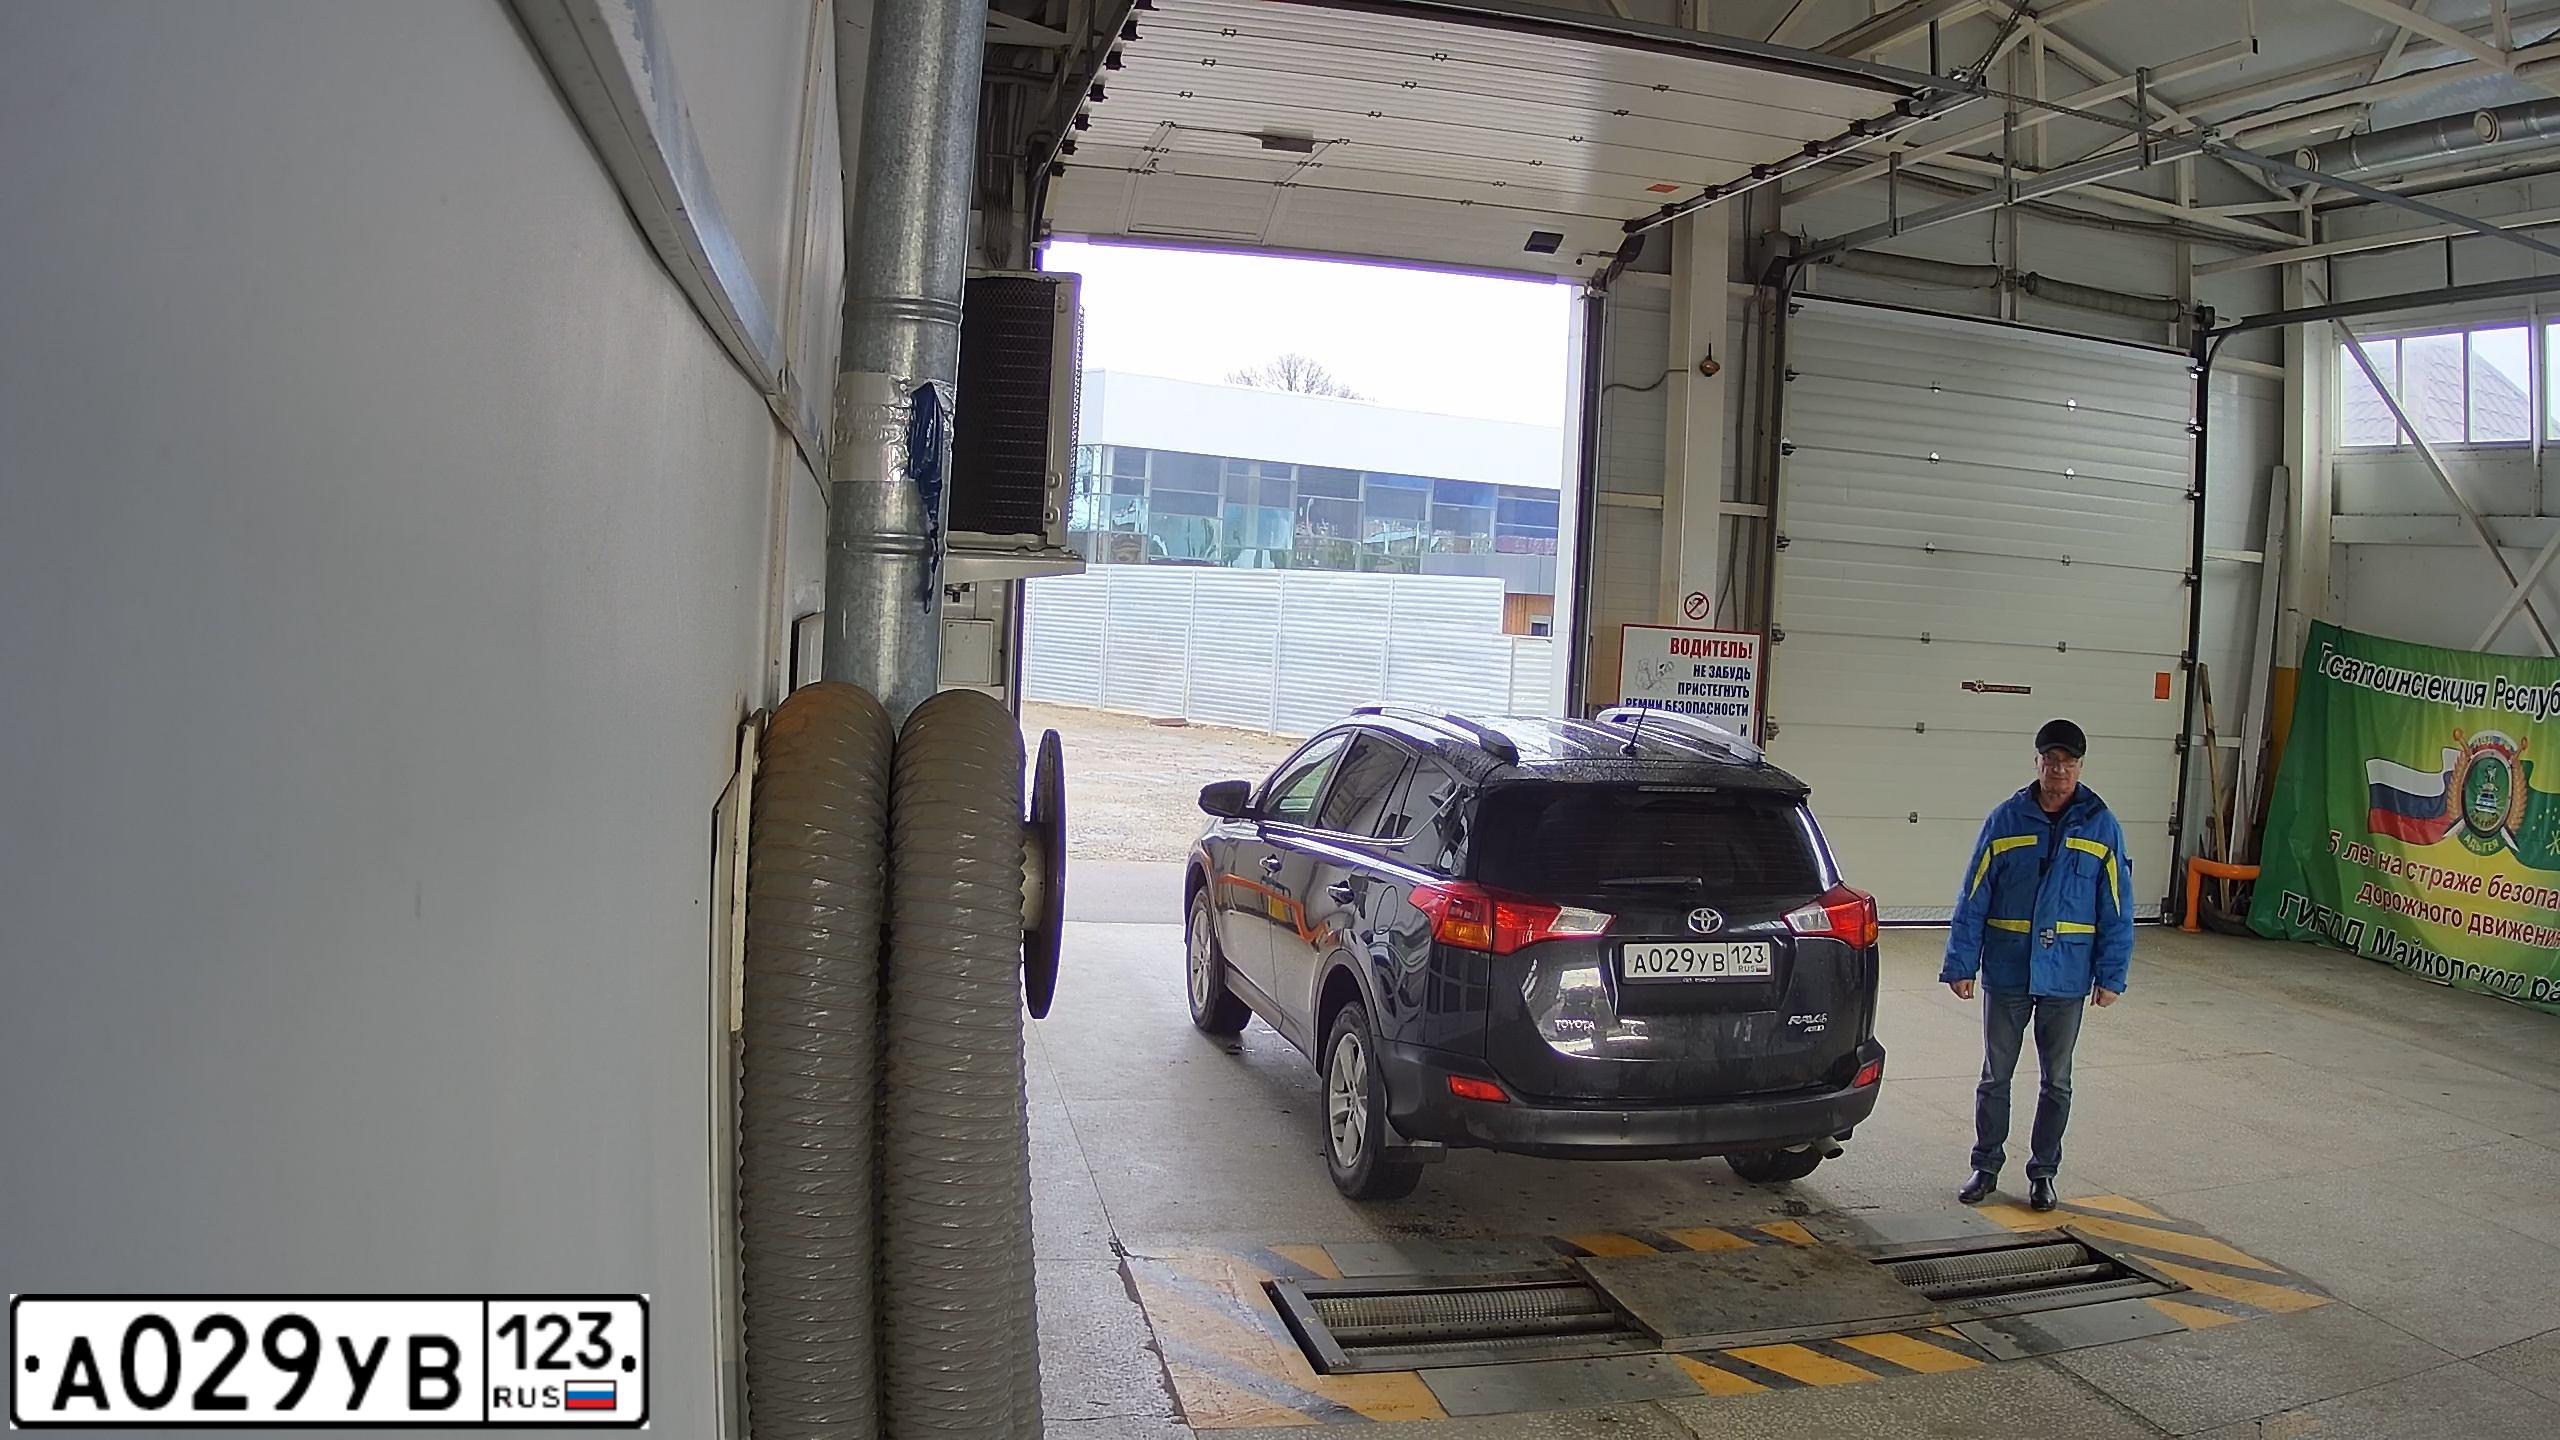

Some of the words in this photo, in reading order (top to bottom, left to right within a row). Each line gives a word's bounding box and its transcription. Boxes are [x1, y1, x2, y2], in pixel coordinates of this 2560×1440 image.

[1670, 637, 1753, 659] ВОДИТЕЛЬ!
[1693, 664, 1706, 677] НЕ
[1708, 665, 1751, 682] ЗАБУДЬ
[1677, 682, 1750, 699] ПРИСТЕГНУТЬ
[1665, 700, 1749, 717] БЕЗОПАСНОСТИ
[1740, 724, 1748, 736] И
[2378, 850, 2402, 876] на
[2406, 861, 2483, 894] страже
[2487, 873, 2560, 911] безопа
[2355, 881, 2463, 928] дорожного
[1633, 947, 1725, 974] А029УВ
[1731, 945, 1764, 964] 123
[1738, 965, 1755, 973] RUS
[1555, 1019, 1596, 1031] TOYOTA
